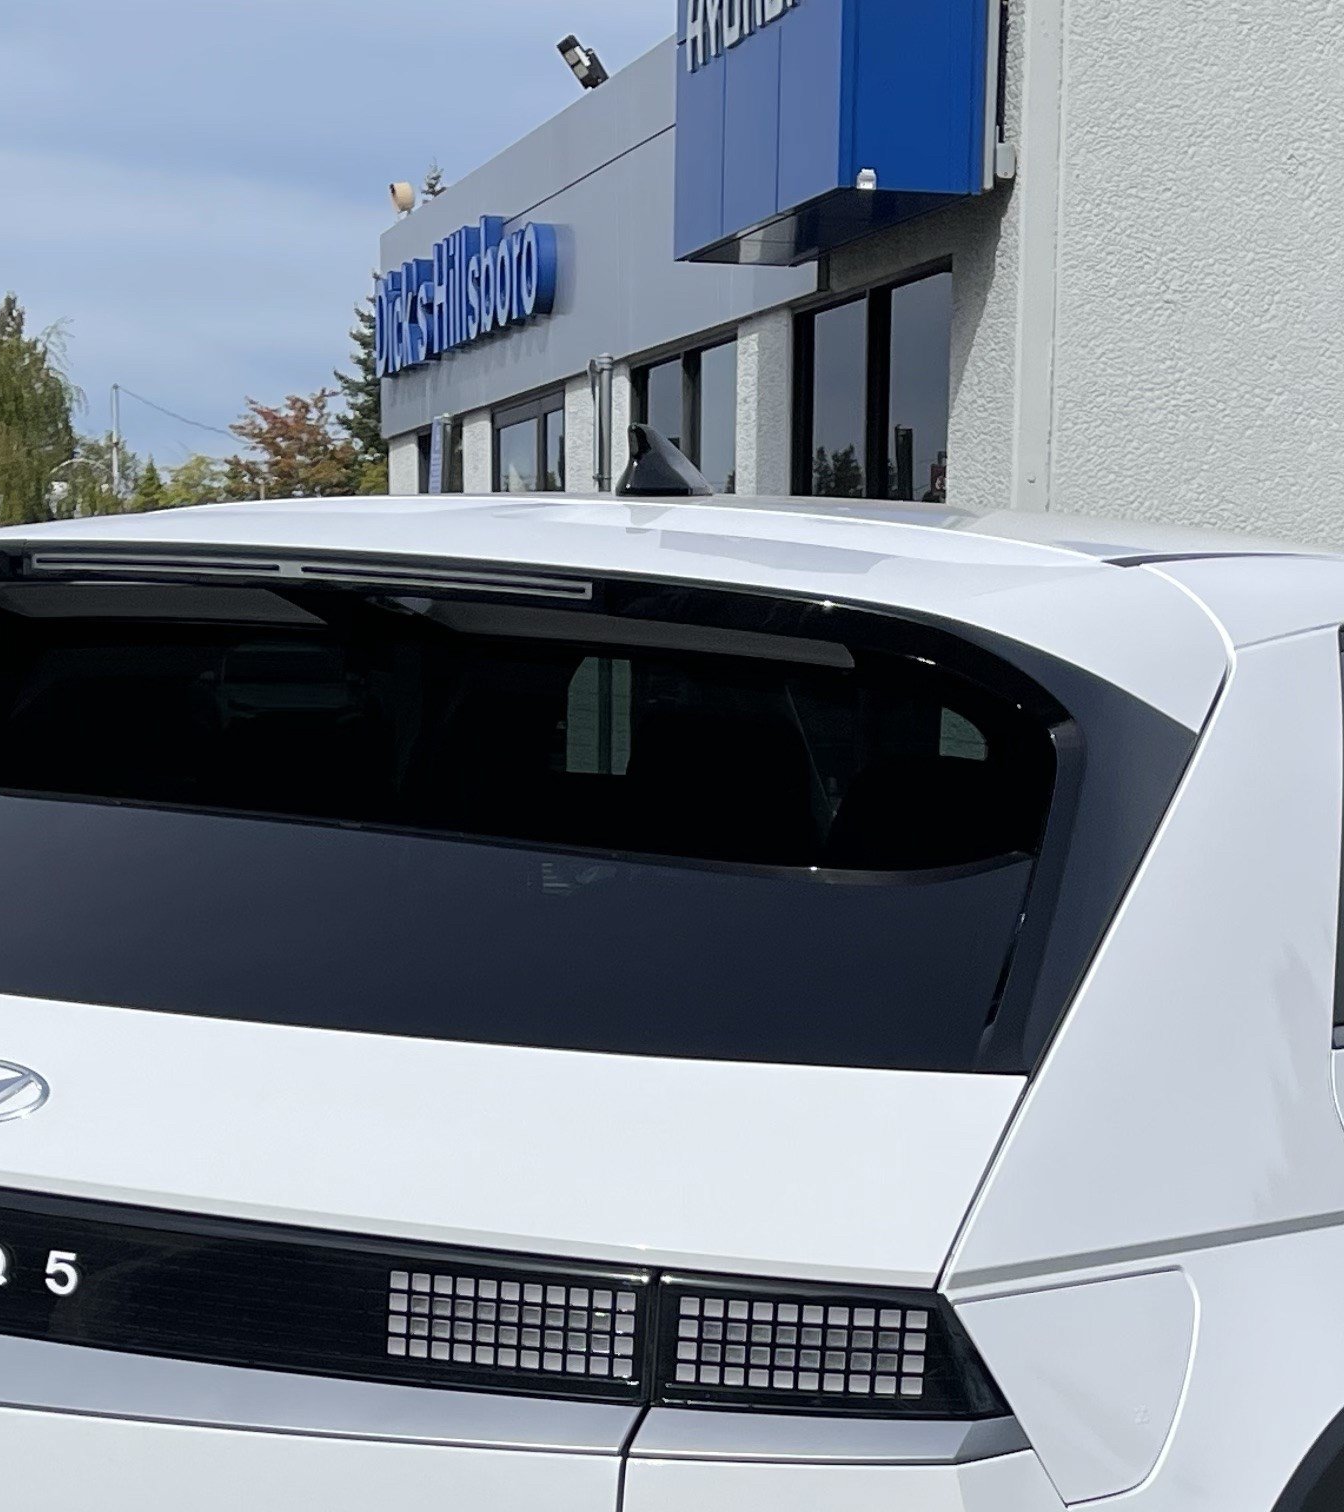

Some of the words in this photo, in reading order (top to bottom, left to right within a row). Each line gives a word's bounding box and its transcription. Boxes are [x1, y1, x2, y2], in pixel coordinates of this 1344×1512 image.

[375, 259, 429, 378] Dick's
[433, 215, 544, 354] Hillsboro
[45, 1250, 78, 1296] 5
